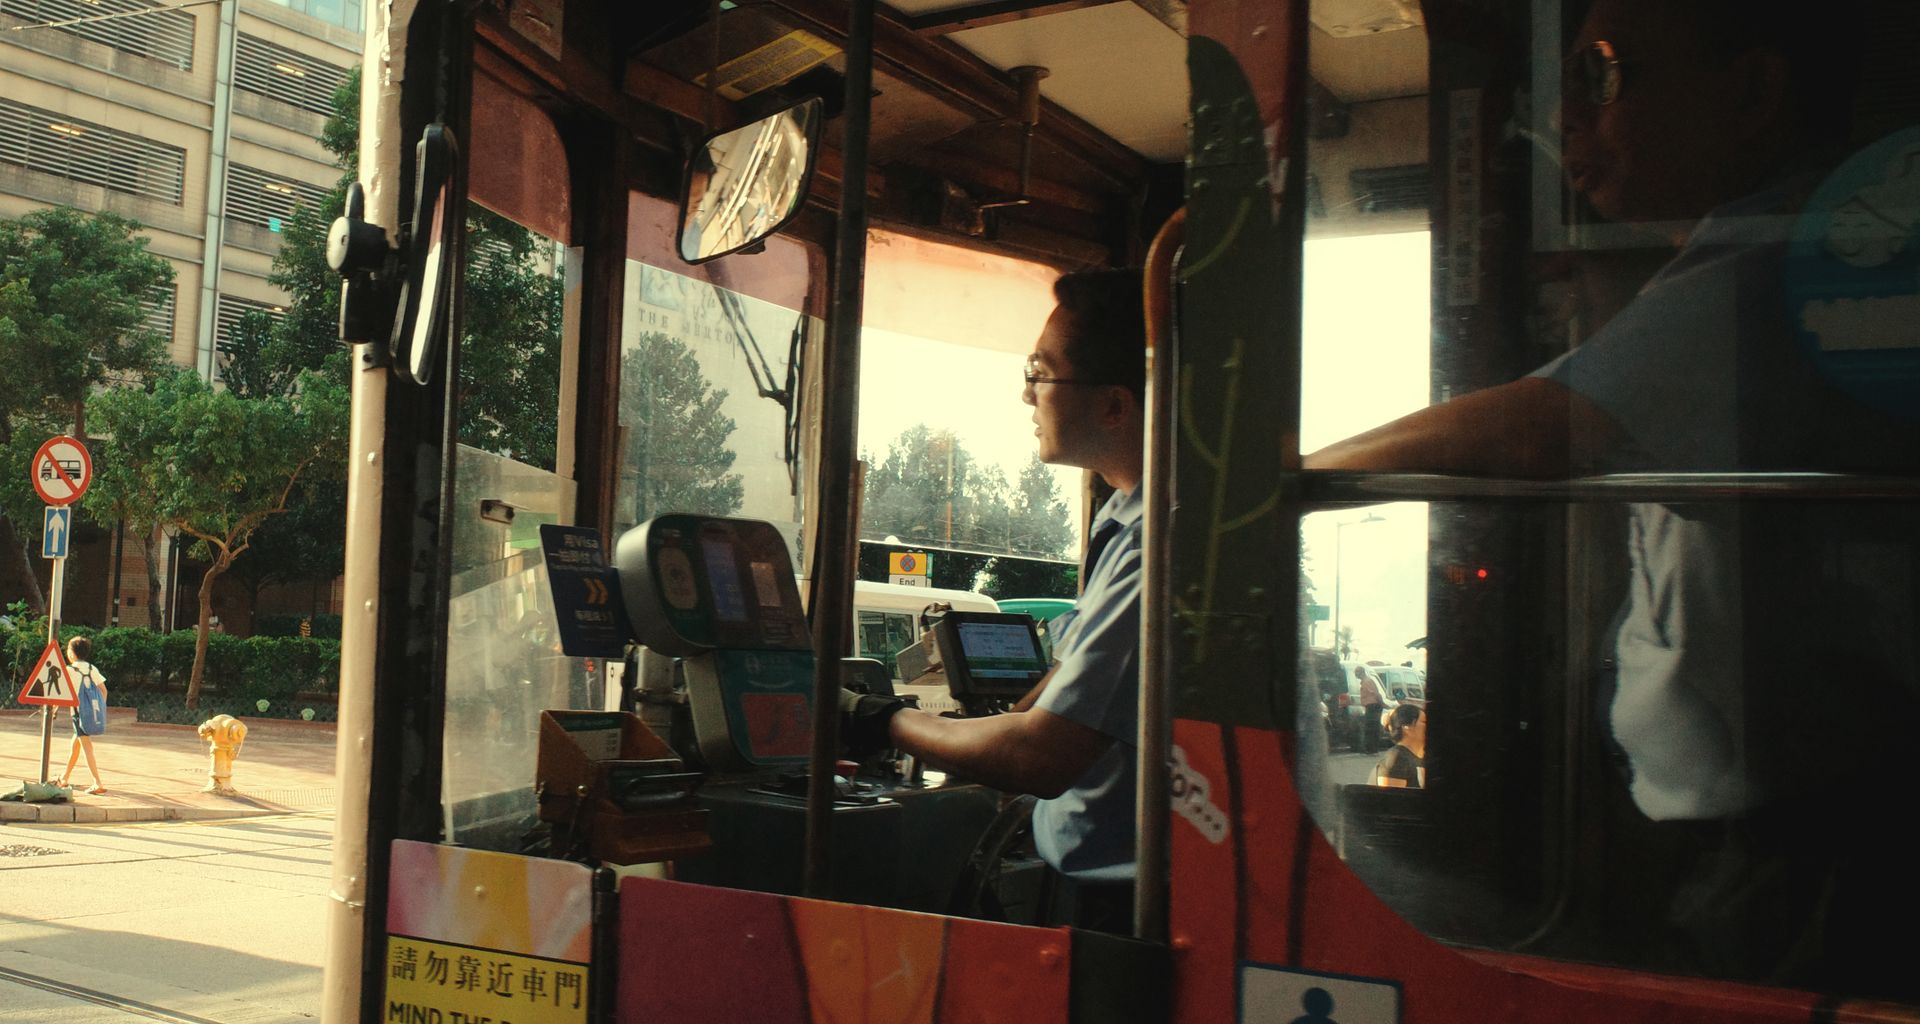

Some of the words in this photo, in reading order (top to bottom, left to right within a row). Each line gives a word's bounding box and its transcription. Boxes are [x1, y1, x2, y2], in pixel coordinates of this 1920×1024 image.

[682, 320, 740, 346] MERTO
[899, 577, 916, 586] End
[392, 945, 582, 1010] 請勿靠近車門
[389, 1000, 443, 1024] MIND
